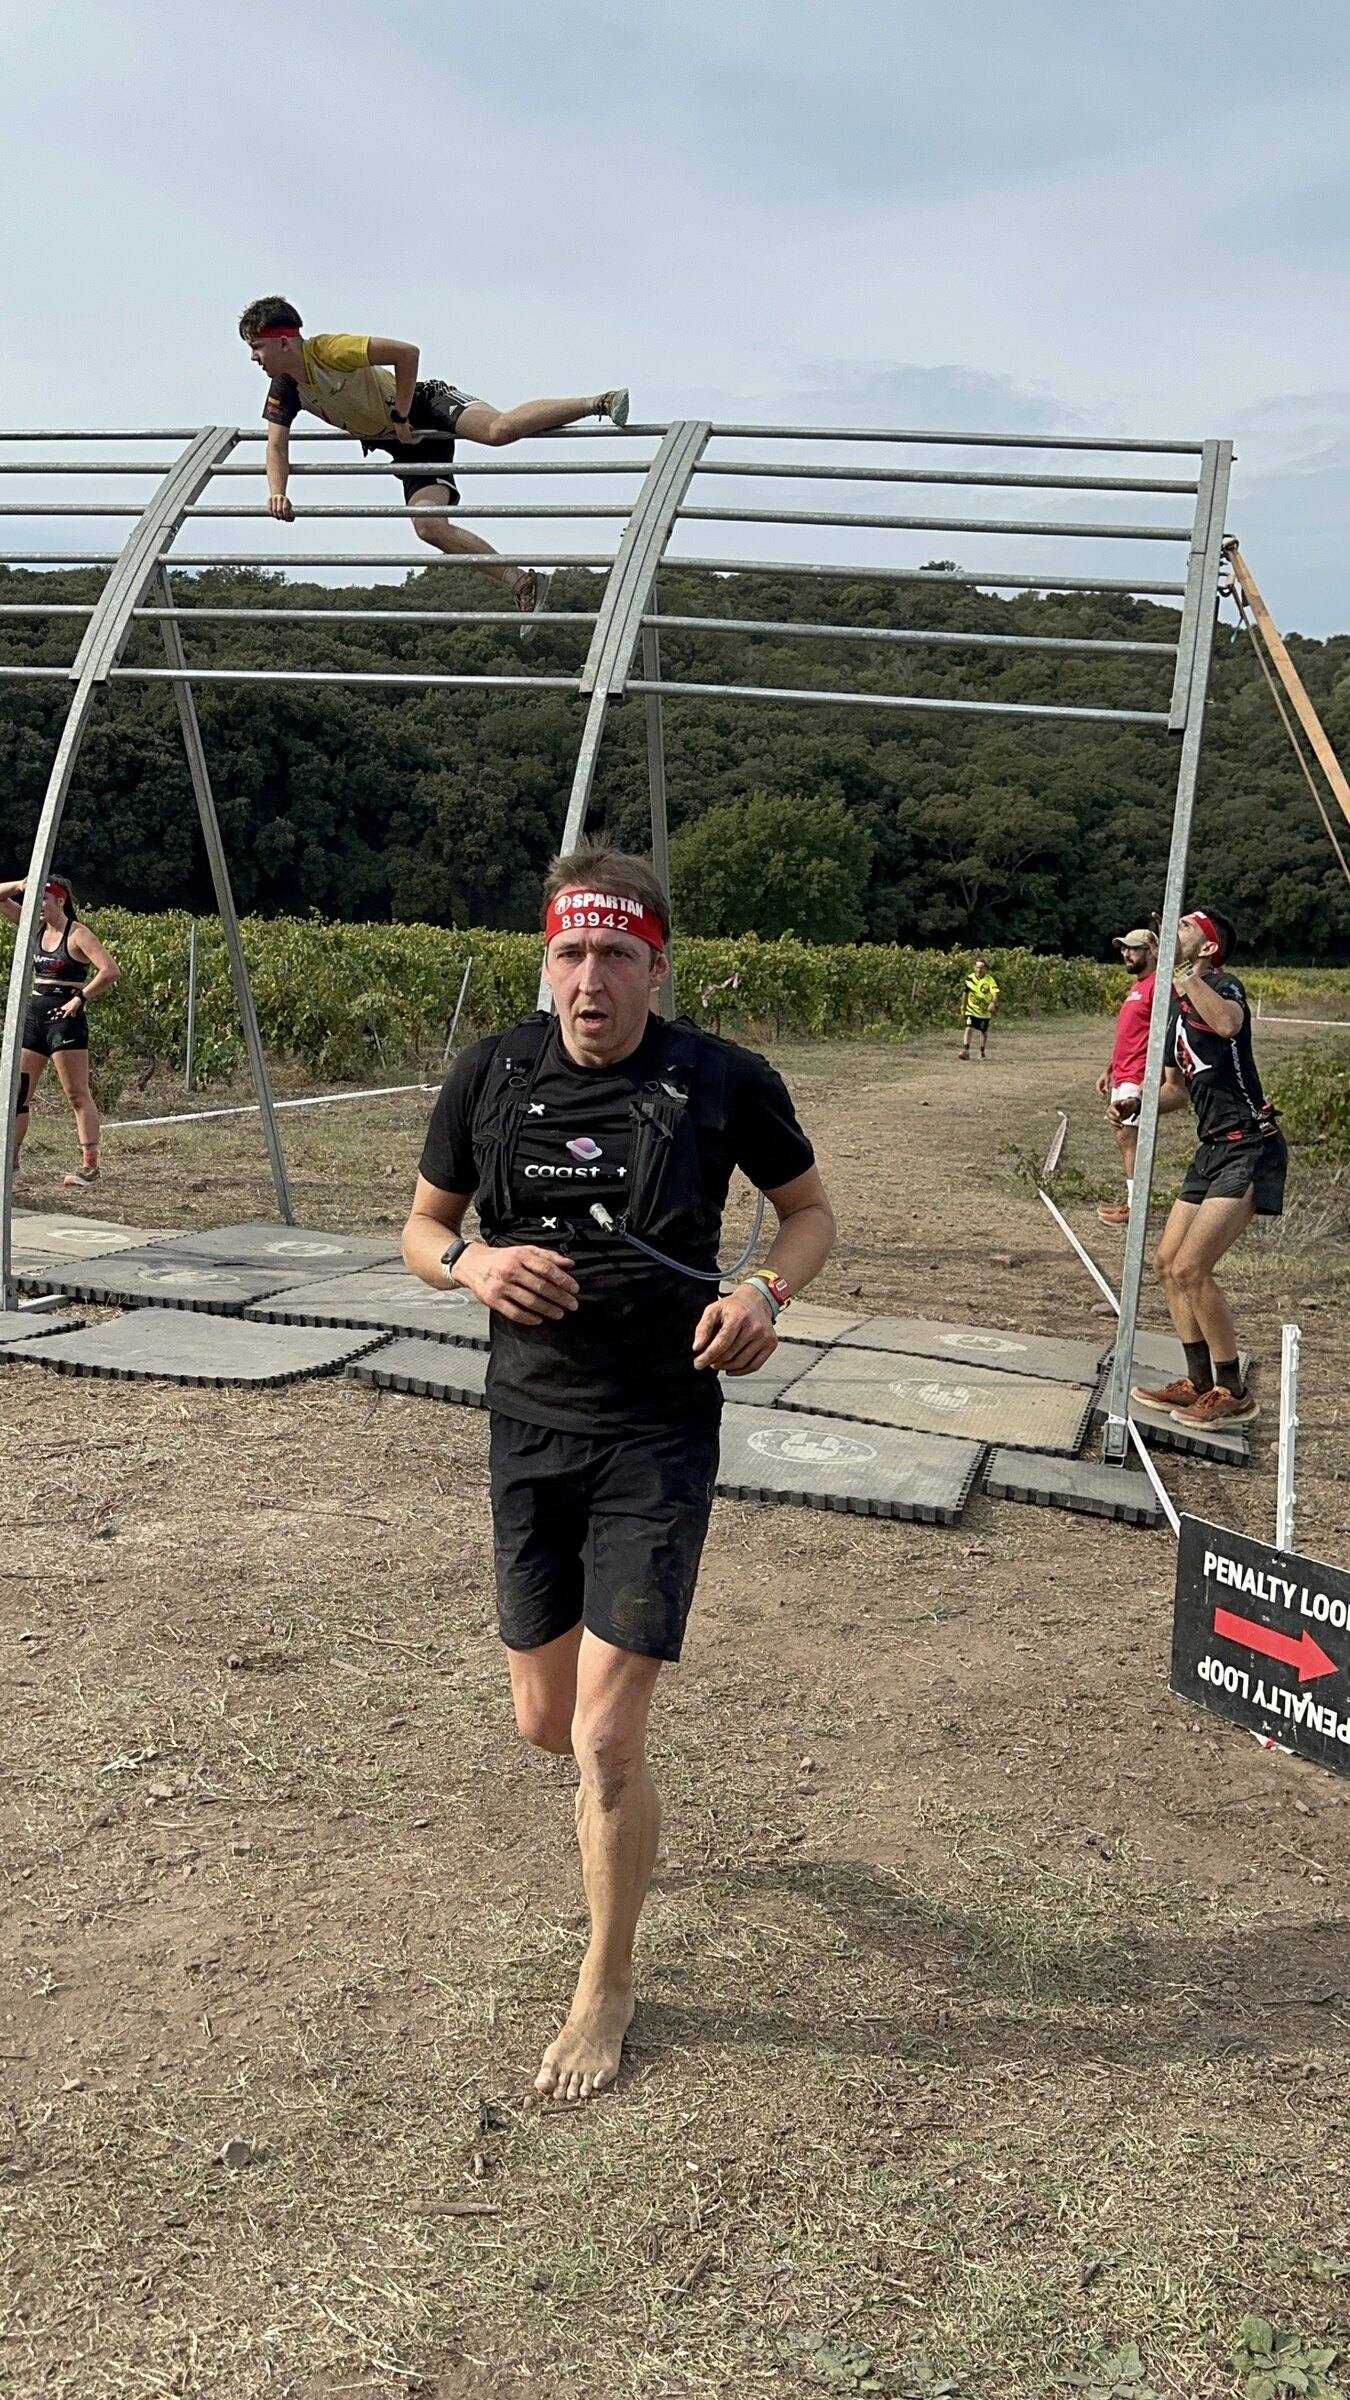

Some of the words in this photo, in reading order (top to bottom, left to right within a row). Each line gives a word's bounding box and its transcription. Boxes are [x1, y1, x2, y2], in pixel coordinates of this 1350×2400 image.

[561, 912, 629, 930] 89942
[572, 893, 643, 919] SPARTAN
[1204, 1551, 1297, 1609] PENALTY
[1197, 1655, 1250, 1699] LOOP
[1252, 1680, 1350, 1745] PENALTY
